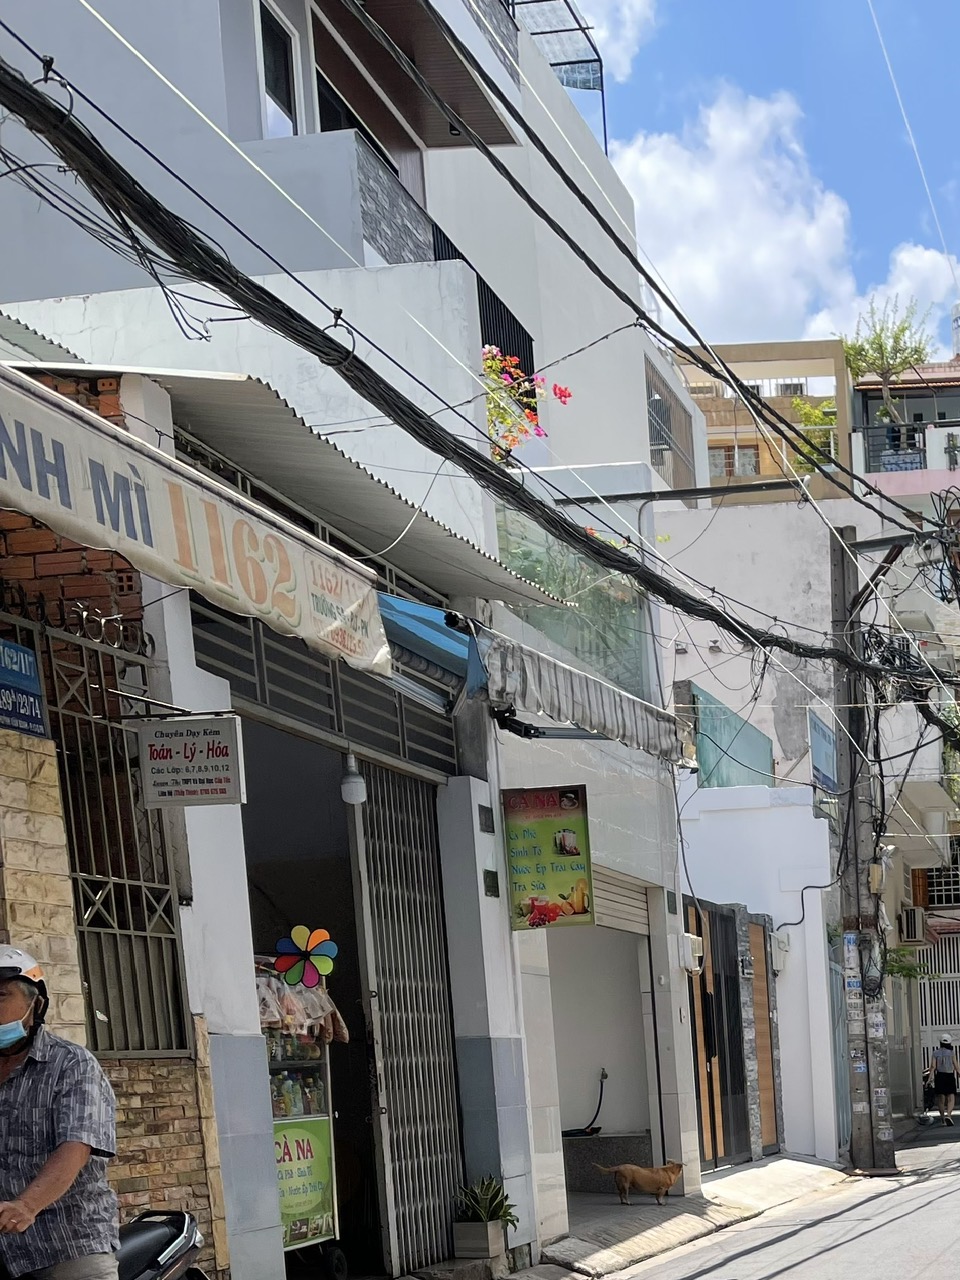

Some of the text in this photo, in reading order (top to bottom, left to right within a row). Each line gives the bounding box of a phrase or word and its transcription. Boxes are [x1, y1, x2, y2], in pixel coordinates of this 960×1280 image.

[88, 458, 153, 548] MÌ
[162, 478, 302, 628] 1162
[148, 743, 173, 761] Toán
[184, 742, 197, 763] Lý
[206, 739, 229, 760] Hóa
[275, 1134, 314, 1164] CÀ NA
